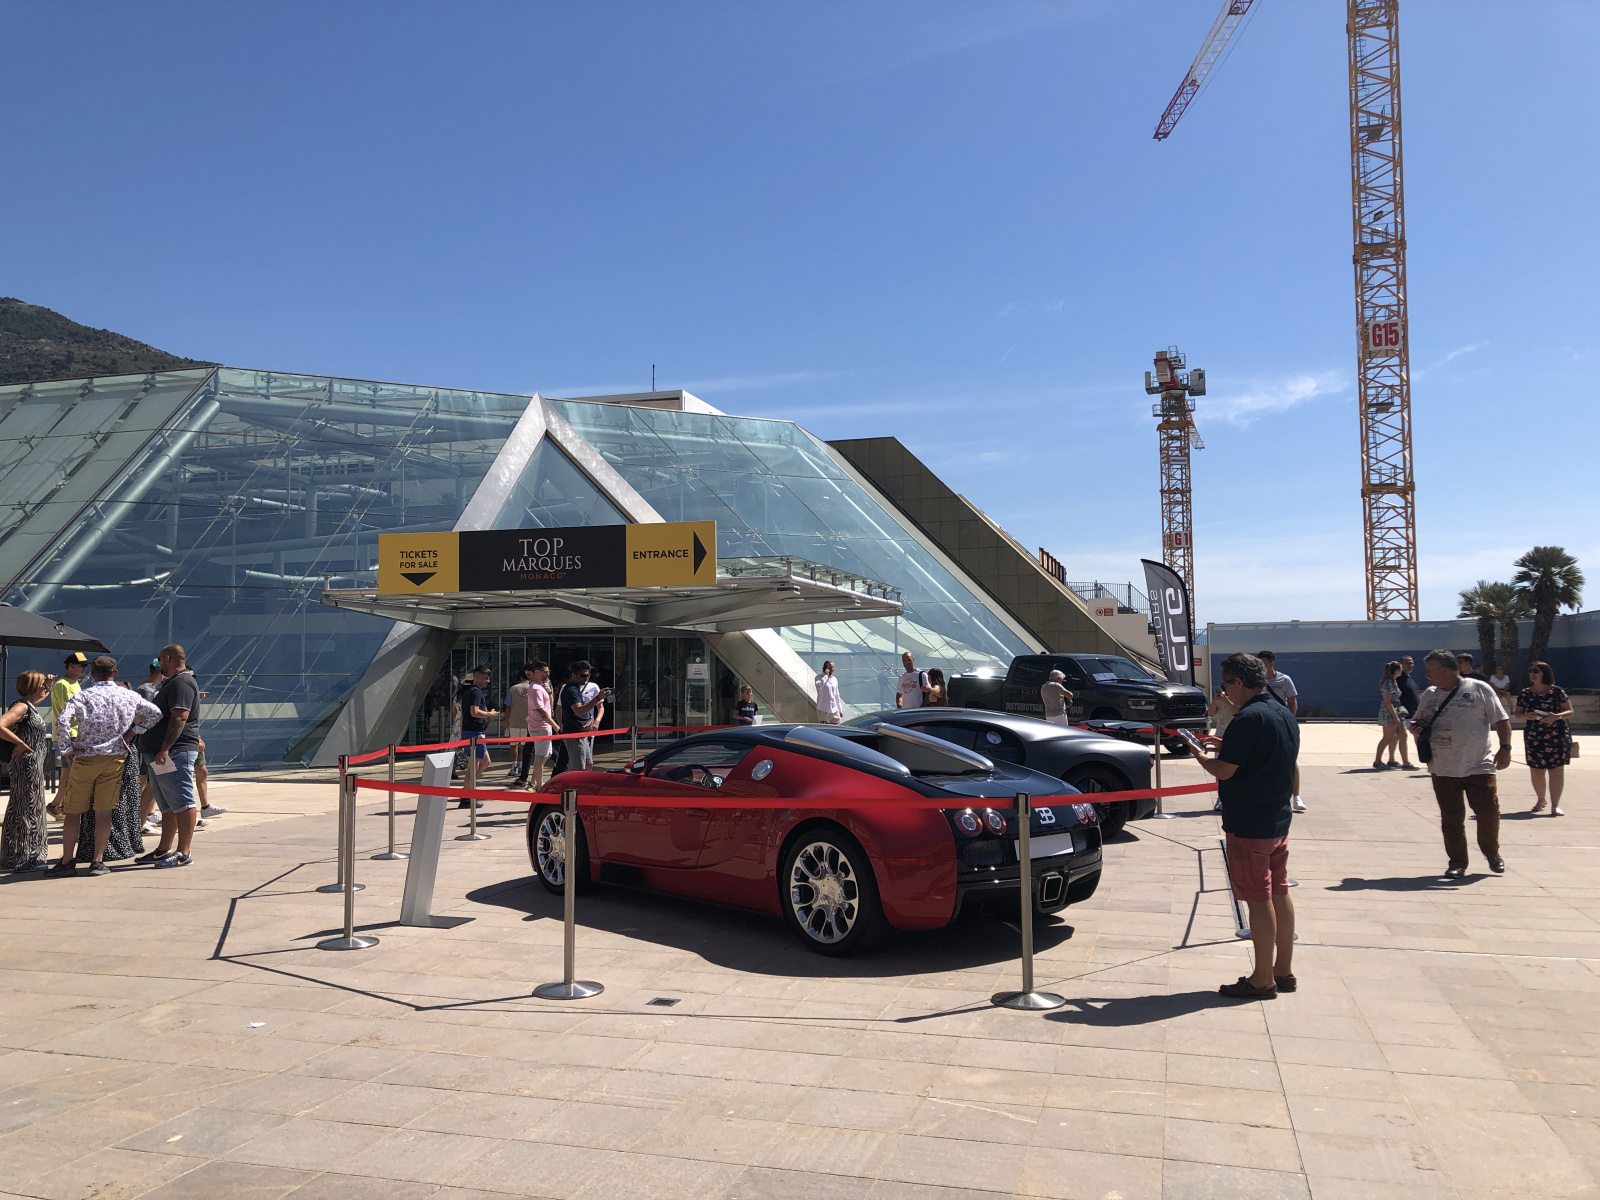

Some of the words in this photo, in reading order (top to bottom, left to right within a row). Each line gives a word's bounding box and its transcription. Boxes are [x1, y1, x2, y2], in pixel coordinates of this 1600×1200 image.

[1372, 322, 1399, 347] G15
[518, 537, 564, 557] TOP
[400, 550, 438, 559] TICKETS
[633, 549, 689, 560] ENTRANCE
[400, 561, 416, 569] FOR
[418, 560, 438, 568] SALE
[502, 555, 582, 572] MARQUES
[520, 572, 564, 580] MONACO
[1069, 706, 1084, 714] RAM
